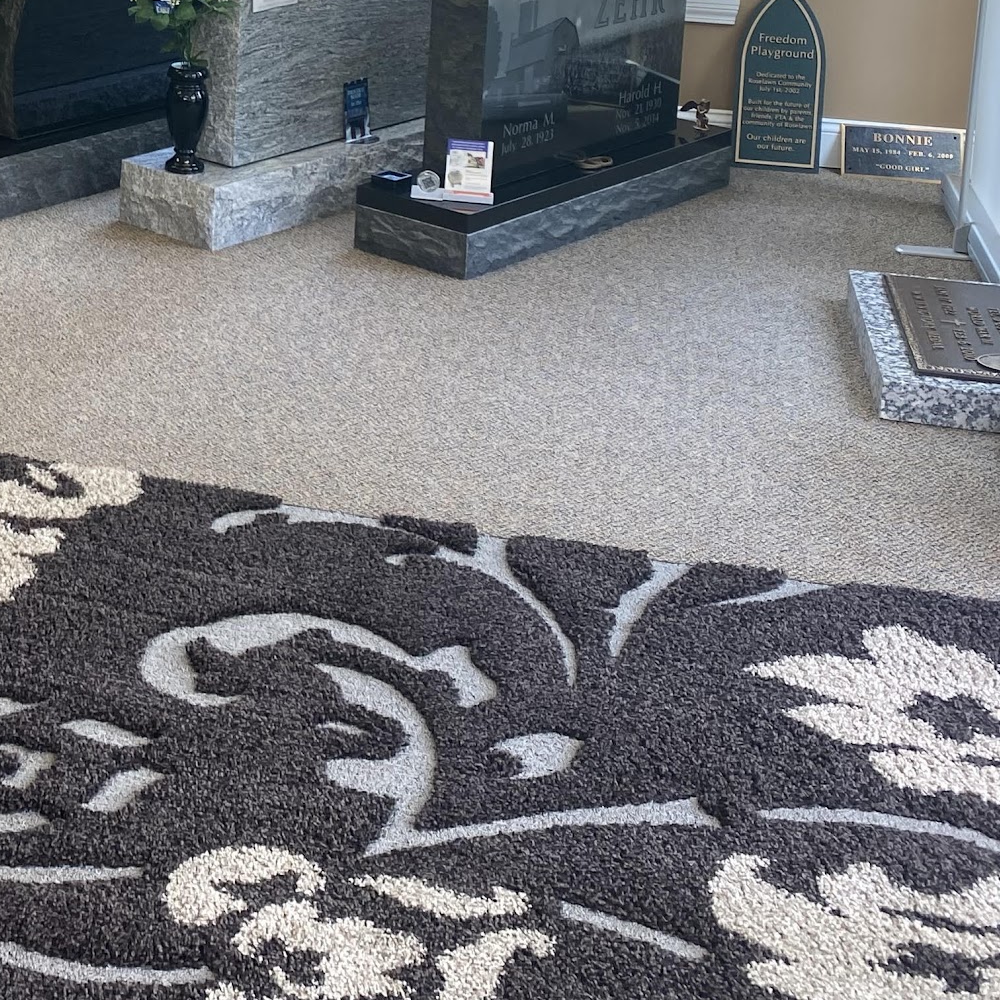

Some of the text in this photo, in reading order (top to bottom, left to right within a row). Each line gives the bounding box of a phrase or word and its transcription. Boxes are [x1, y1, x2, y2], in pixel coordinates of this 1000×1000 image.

[759, 32, 807, 45] Freedom
[751, 46, 814, 60] Playground
[756, 71, 787, 79] Dedicated
[777, 80, 812, 89] Community
[618, 82, 650, 105] Harold
[503, 118, 538, 139] Norma
[501, 140, 517, 157] July
[536, 128, 555, 146] 1923
[762, 134, 793, 143] children
[873, 132, 933, 147] BONNIE
[851, 146, 870, 154] MAY
